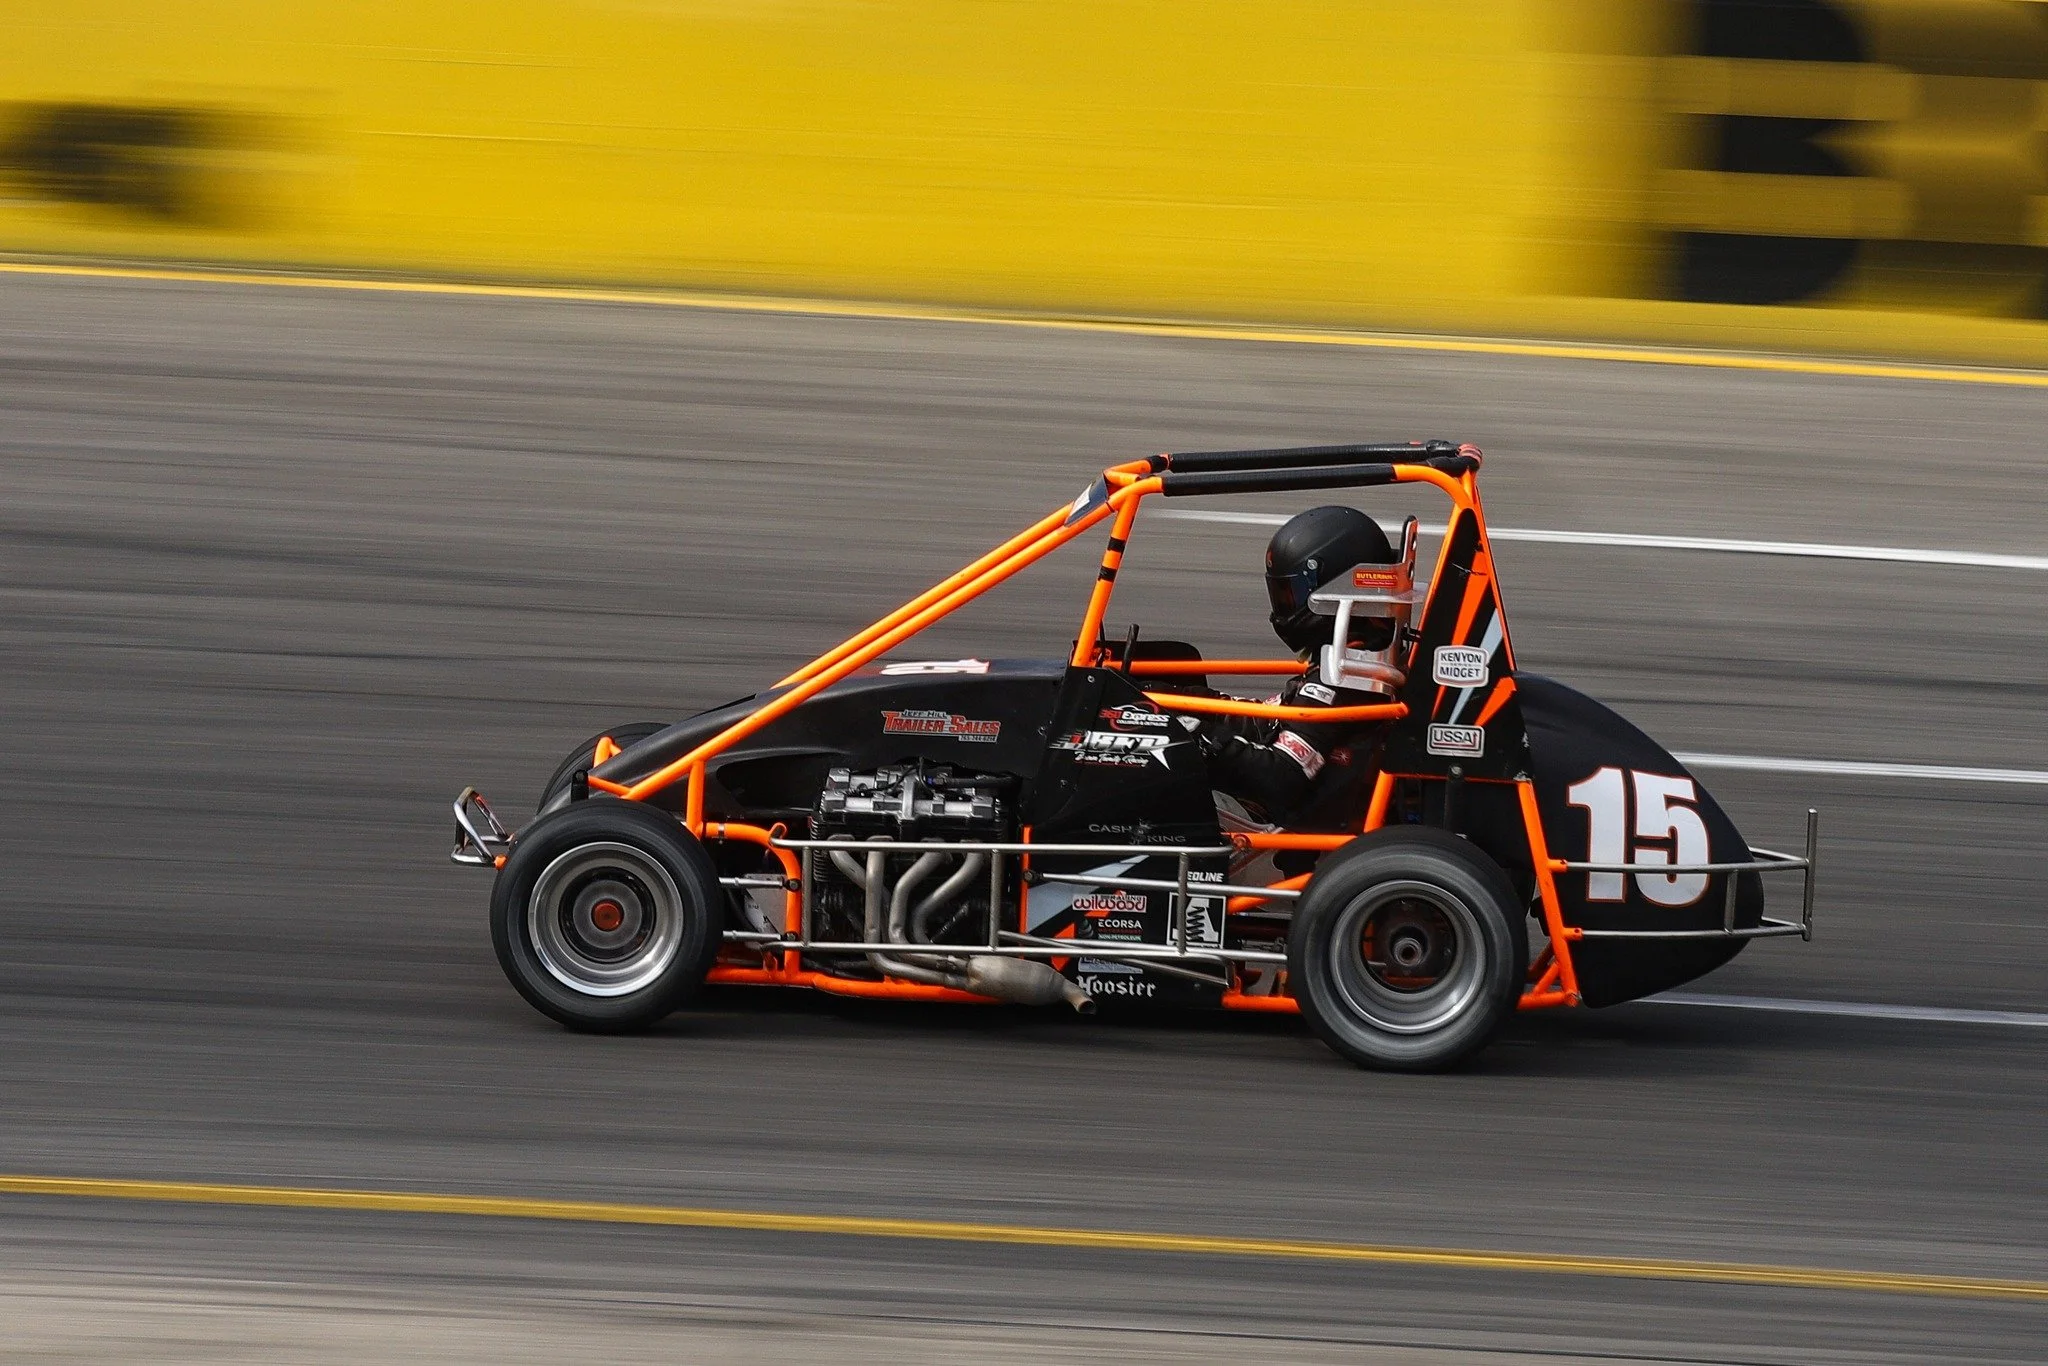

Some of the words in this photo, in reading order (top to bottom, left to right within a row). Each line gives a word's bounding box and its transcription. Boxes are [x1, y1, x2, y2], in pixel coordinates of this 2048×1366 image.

[1440, 652, 1482, 663] KENYON
[1439, 667, 1480, 677] MIDGET
[882, 711, 945, 732] TRAILER
[949, 715, 1000, 734] SALES
[1122, 711, 1170, 722] Express
[1434, 730, 1473, 743] USSA
[1089, 824, 1132, 833] CASH
[1147, 835, 1187, 843] KING
[1566, 766, 1711, 907] 15
[1187, 871, 1224, 882] EDLINE
[1074, 894, 1145, 911] wilwood
[1098, 919, 1143, 929] ECORSA
[1076, 974, 1156, 997] Hoosier
